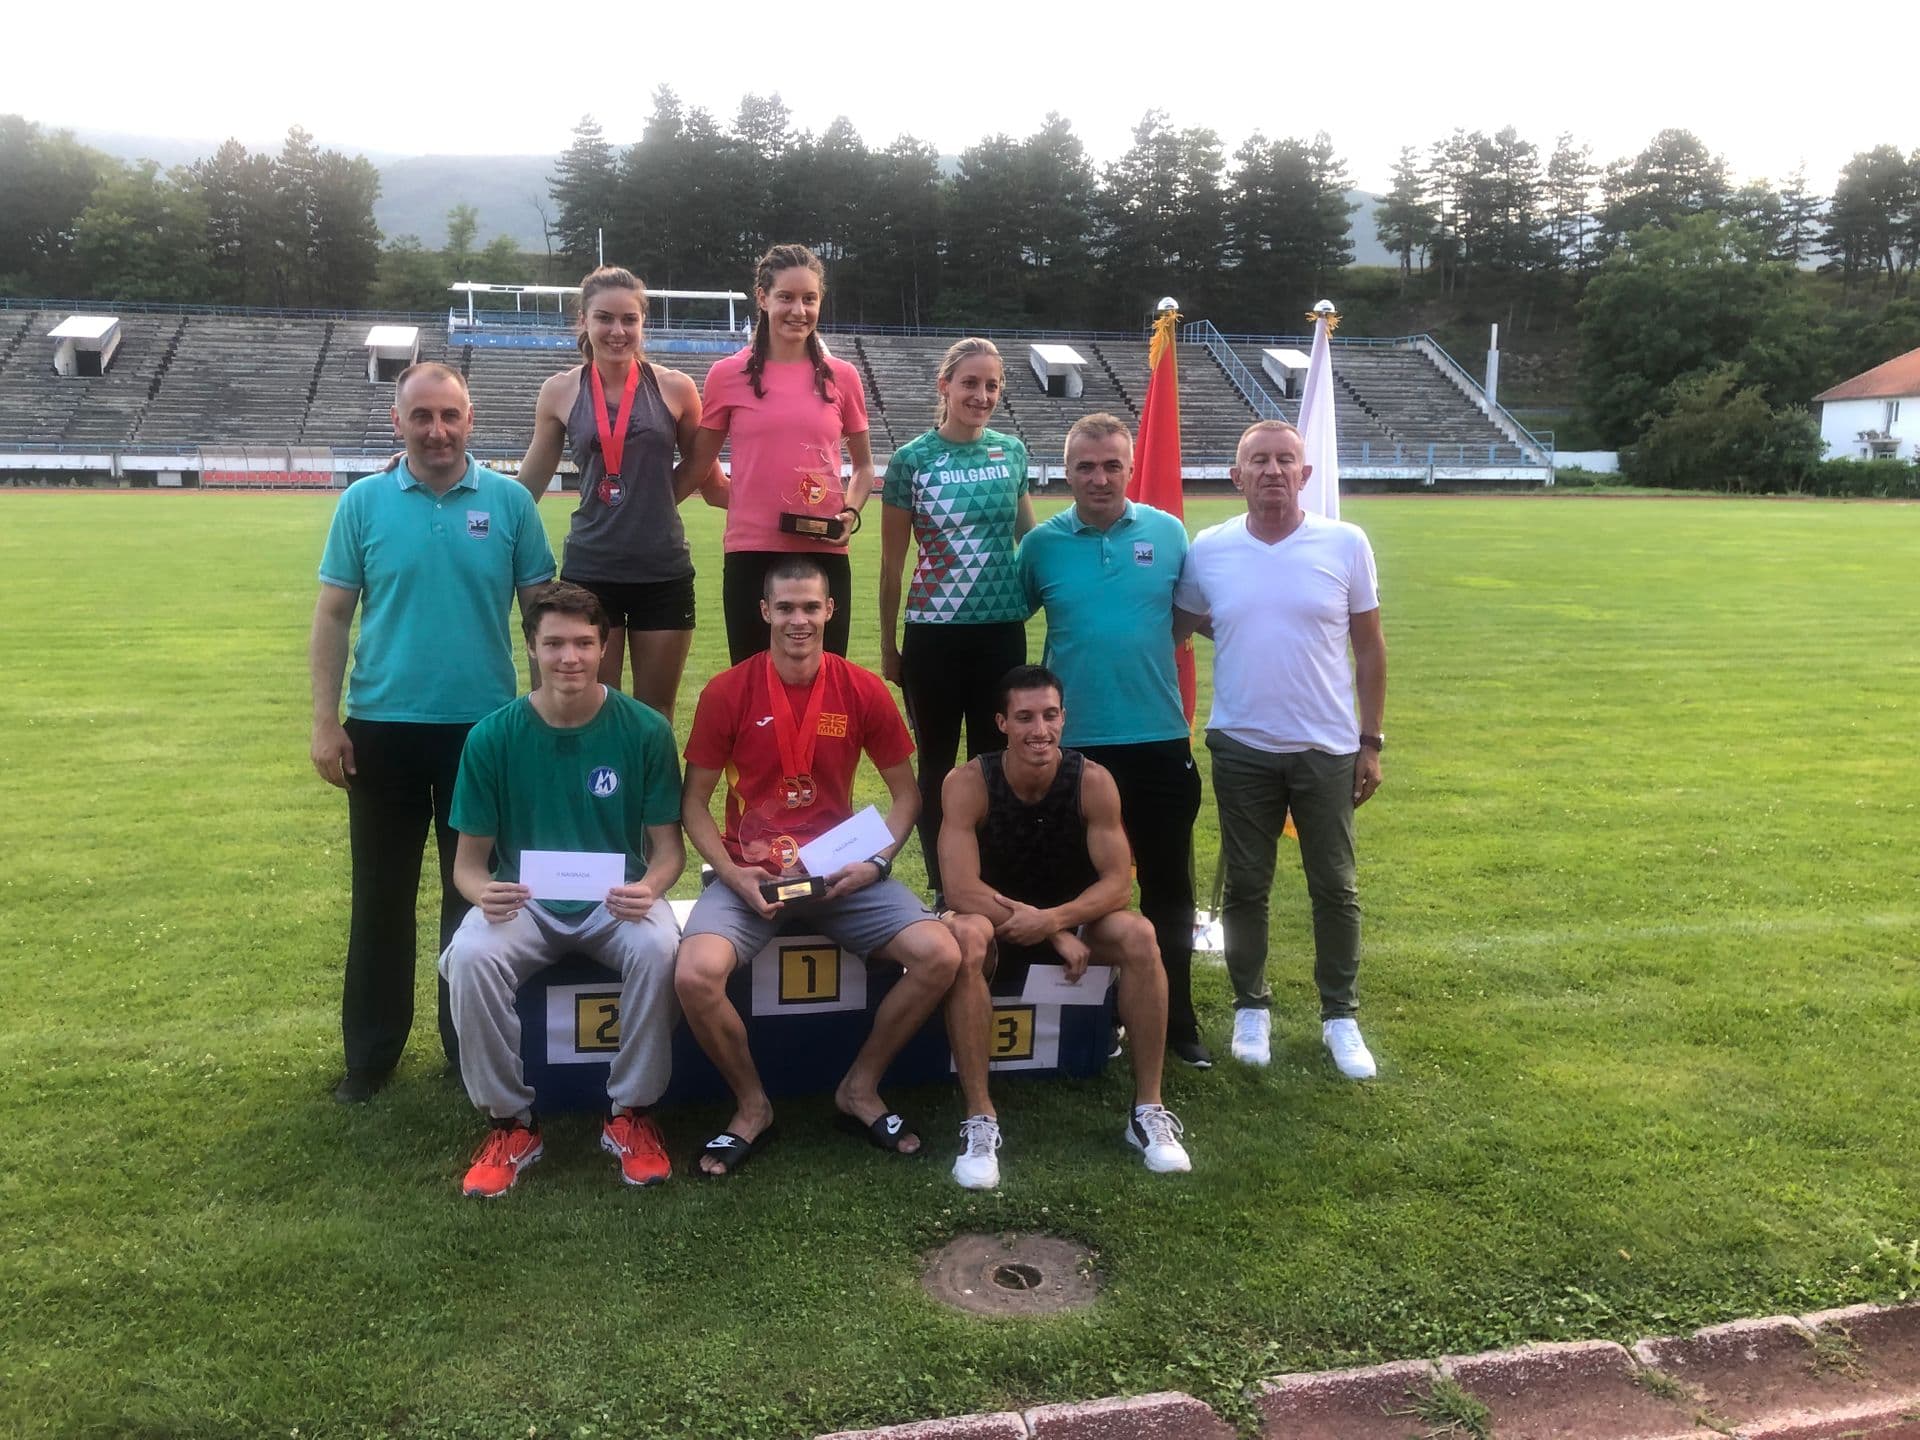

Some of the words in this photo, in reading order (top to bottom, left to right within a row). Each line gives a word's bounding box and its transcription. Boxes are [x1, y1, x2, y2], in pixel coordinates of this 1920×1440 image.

[940, 464, 1010, 484] BULGARIA
[818, 725, 844, 735] MKD
[801, 955, 816, 993] 1
[595, 1003, 620, 1043] 2
[997, 1016, 1018, 1052] 3
